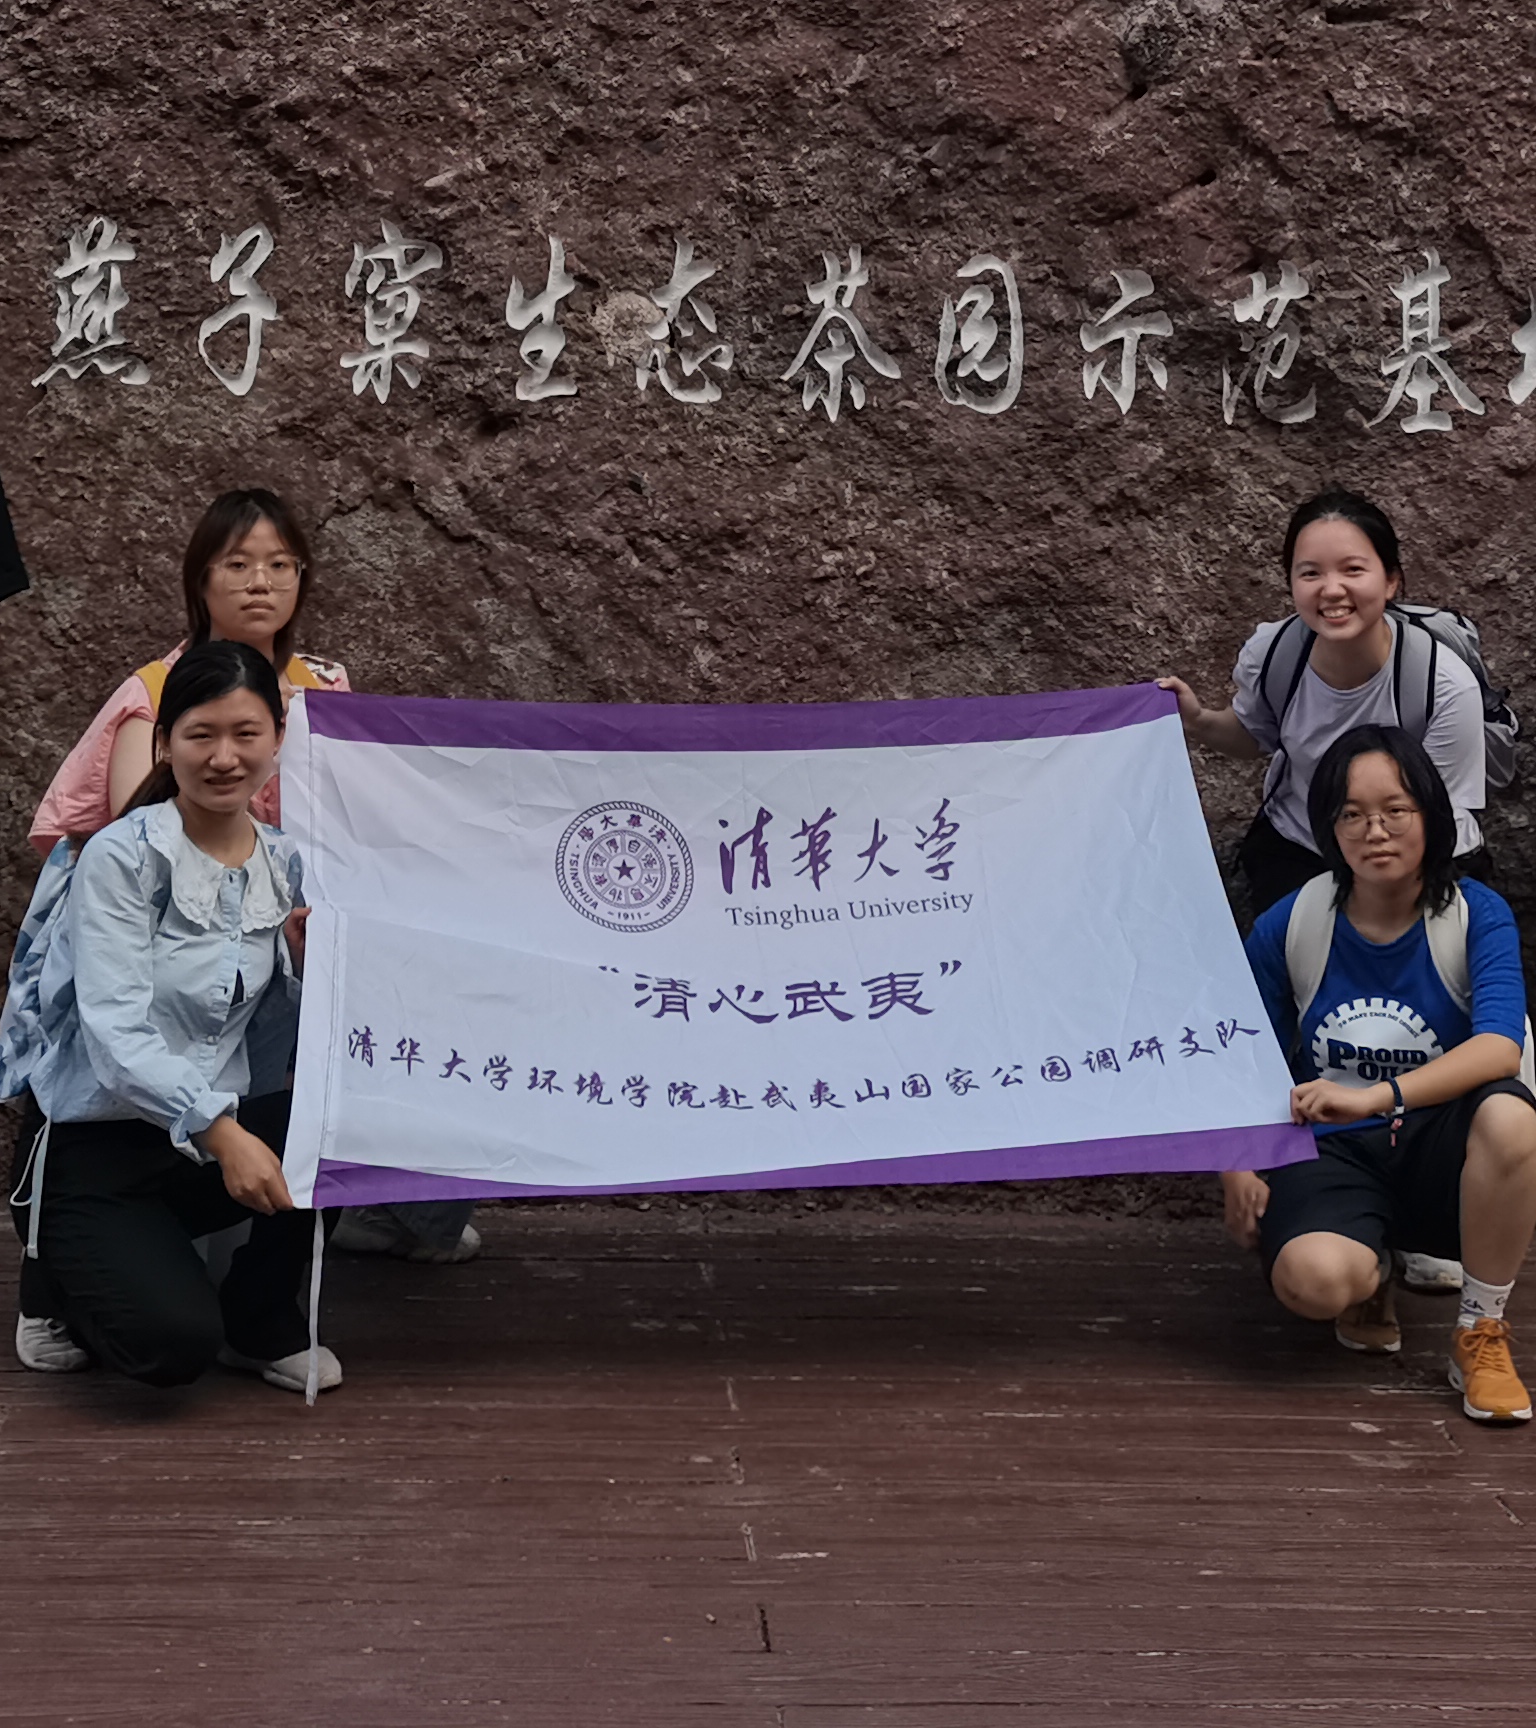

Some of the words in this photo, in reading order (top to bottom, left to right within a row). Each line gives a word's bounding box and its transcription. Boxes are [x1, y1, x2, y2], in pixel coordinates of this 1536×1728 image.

[568, 852, 599, 911] TSINGHUA
[656, 853, 681, 911] UNIVERSITY
[725, 903, 840, 931] Tsinghua
[847, 890, 975, 921] University
